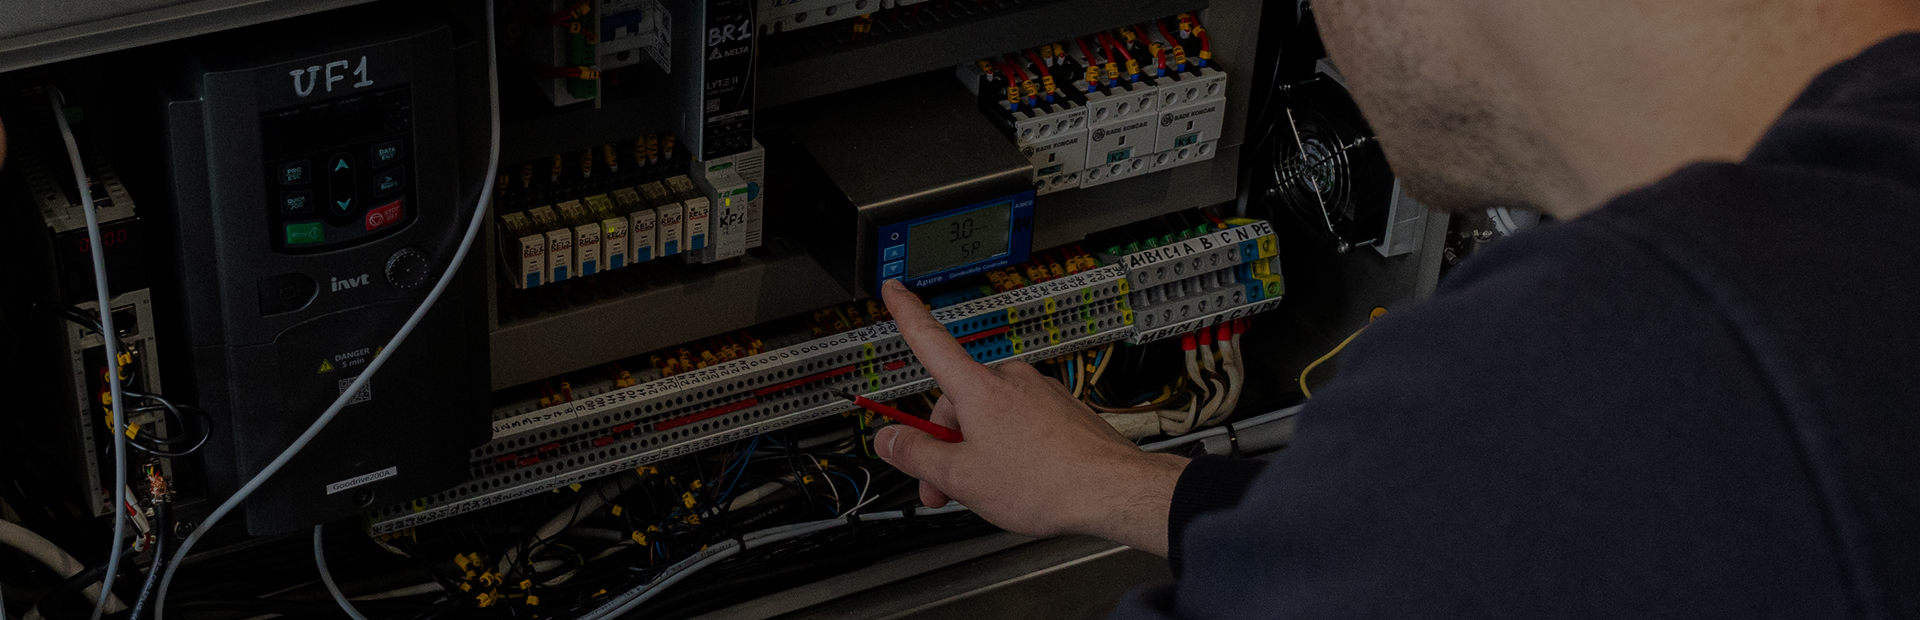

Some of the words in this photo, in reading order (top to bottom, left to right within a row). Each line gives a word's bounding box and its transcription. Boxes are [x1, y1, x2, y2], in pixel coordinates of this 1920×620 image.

[708, 20, 752, 46] BR1
[289, 56, 374, 98] UF1
[707, 78, 730, 90] LYTE
[1178, 136, 1191, 147] K1
[378, 146, 396, 155] DATA
[1036, 144, 1052, 153] RADE
[1111, 152, 1124, 162] K2
[286, 166, 302, 174] PRG
[1014, 200, 1033, 209] A30CD
[384, 206, 400, 215] STOP
[689, 208, 709, 218] REL7
[635, 220, 656, 231] REL5
[1012, 215, 1032, 233] A4
[950, 218, 974, 242] 3.0
[551, 240, 572, 251] REL2
[1130, 252, 1144, 267] A1
[1145, 250, 1161, 263] B1
[1164, 246, 1180, 258] C1
[1183, 243, 1195, 255] A
[1202, 238, 1213, 249] B
[1221, 232, 1231, 243] C
[1237, 227, 1248, 239] N
[1254, 221, 1271, 236] PE
[916, 275, 943, 287] Apure
[949, 264, 982, 278] Conductivity
[983, 259, 1008, 270] Controller
[331, 273, 370, 292] invt
[1139, 331, 1156, 343] A1
[1156, 327, 1174, 339] B1
[1175, 323, 1189, 334] C1
[1194, 319, 1204, 330] A
[1213, 314, 1222, 323] B
[1230, 309, 1240, 319] C
[1245, 305, 1258, 316] N
[1261, 298, 1277, 311] PE
[335, 347, 370, 362] DANGER
[349, 358, 365, 366] min
[333, 470, 390, 491] Goodrive200A
